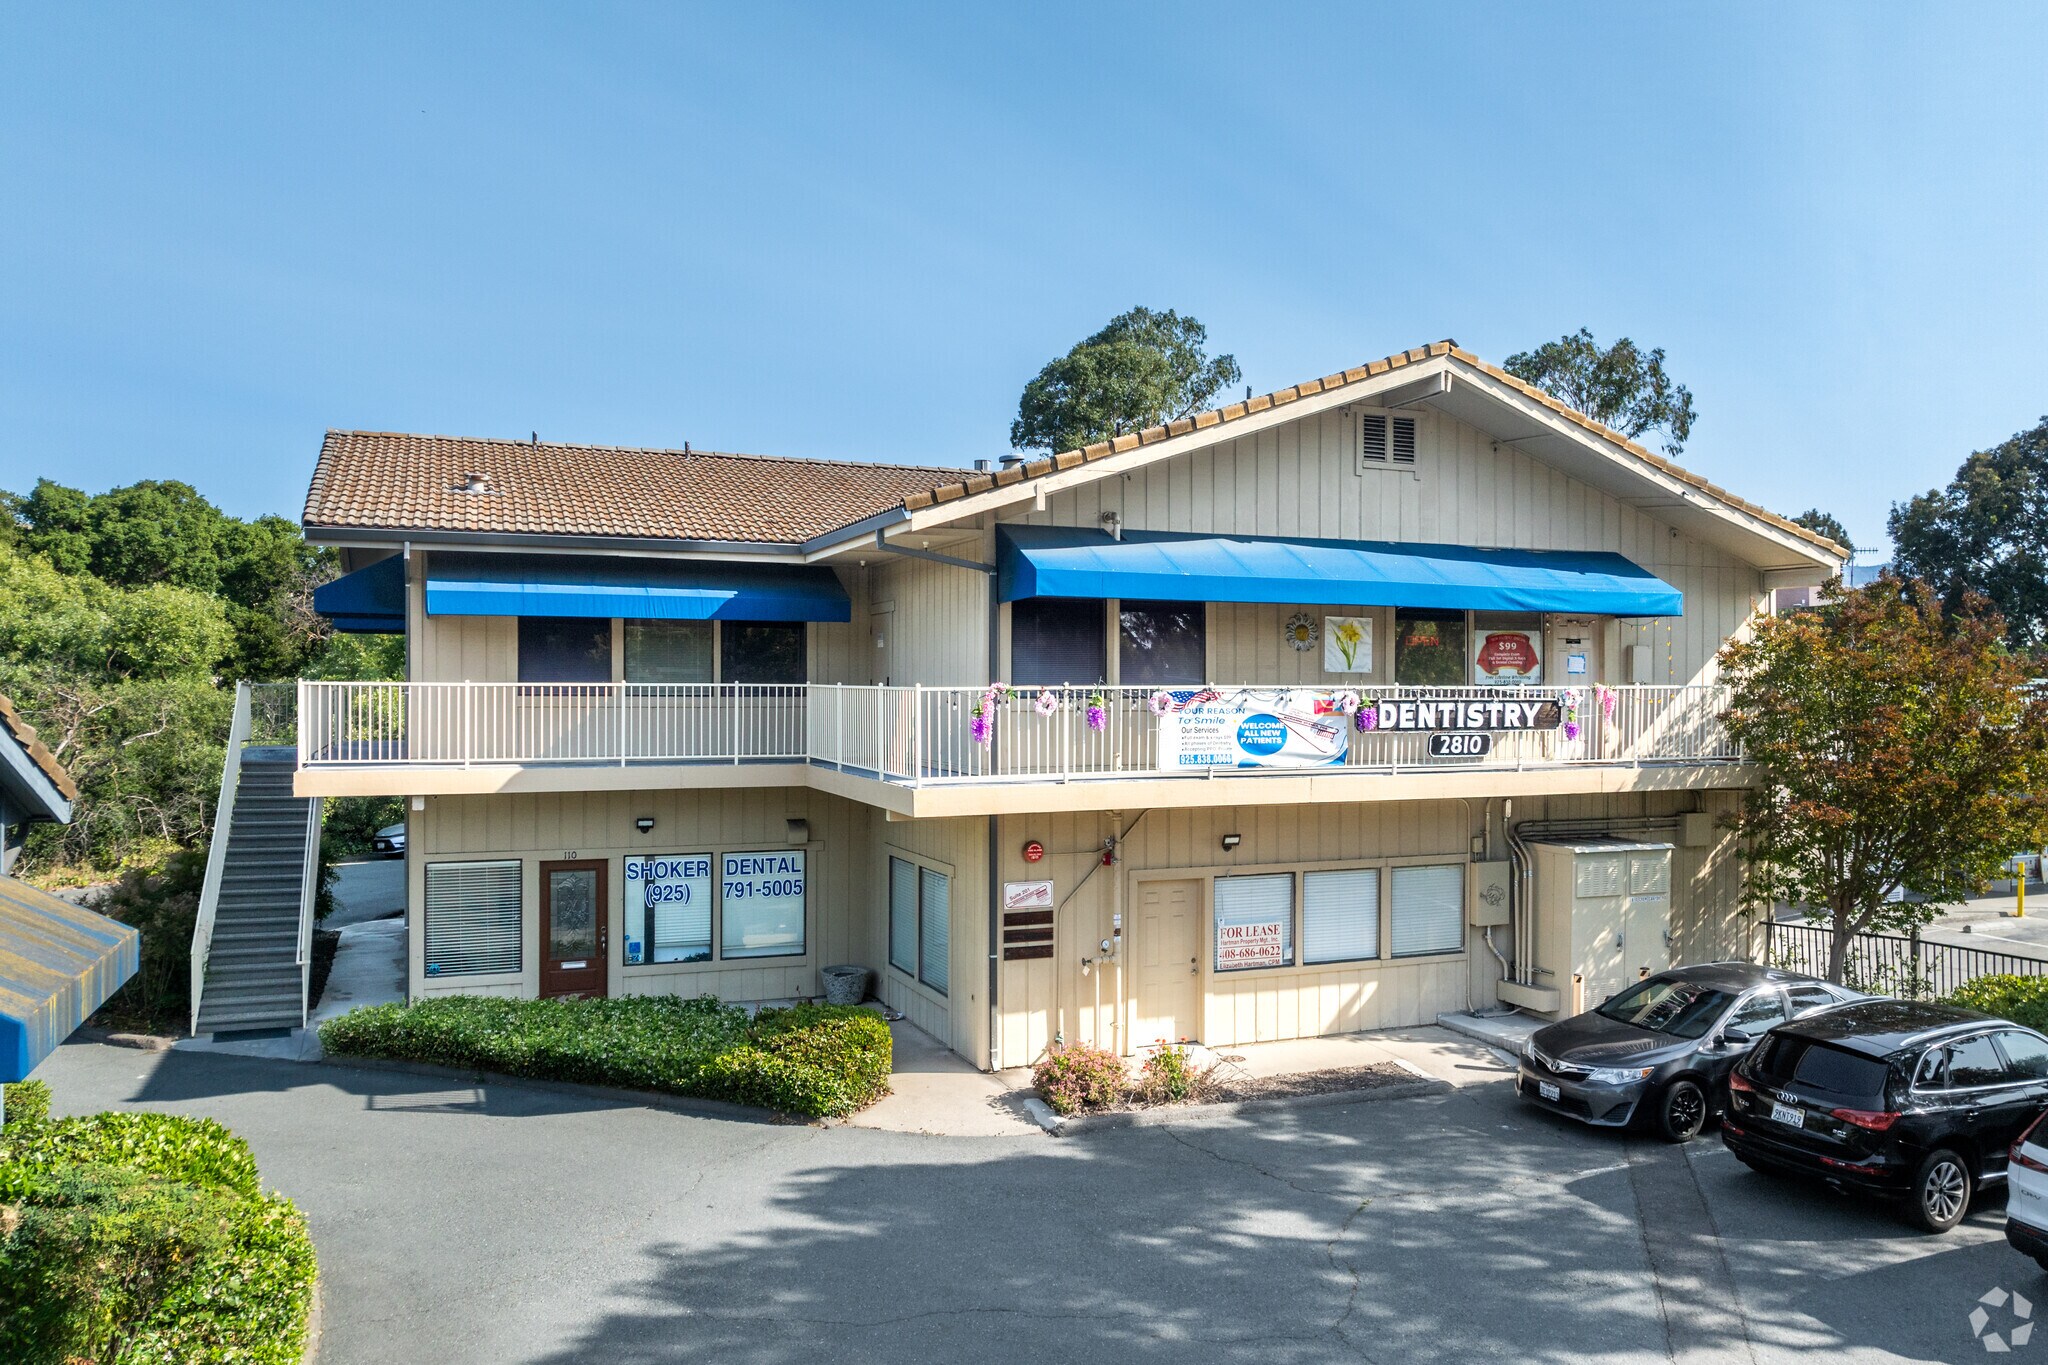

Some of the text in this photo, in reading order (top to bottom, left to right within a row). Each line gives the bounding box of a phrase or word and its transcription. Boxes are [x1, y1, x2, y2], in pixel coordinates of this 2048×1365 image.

[1499, 641, 1517, 650] $99
[1179, 707, 1246, 715] YOUR REASON
[1378, 702, 1543, 729] DENTISTRY
[1194, 716, 1226, 724] Smile
[1181, 726, 1219, 734] Our Services
[1240, 722, 1285, 730] WELCOME
[1244, 729, 1281, 737] ALL NEW
[1440, 736, 1482, 754] 2810
[564, 850, 578, 860] 110
[627, 857, 802, 880] SHOKER DENTAL
[645, 879, 803, 907] (925) 791-5005
[1220, 924, 1281, 939] FOR LEASE
